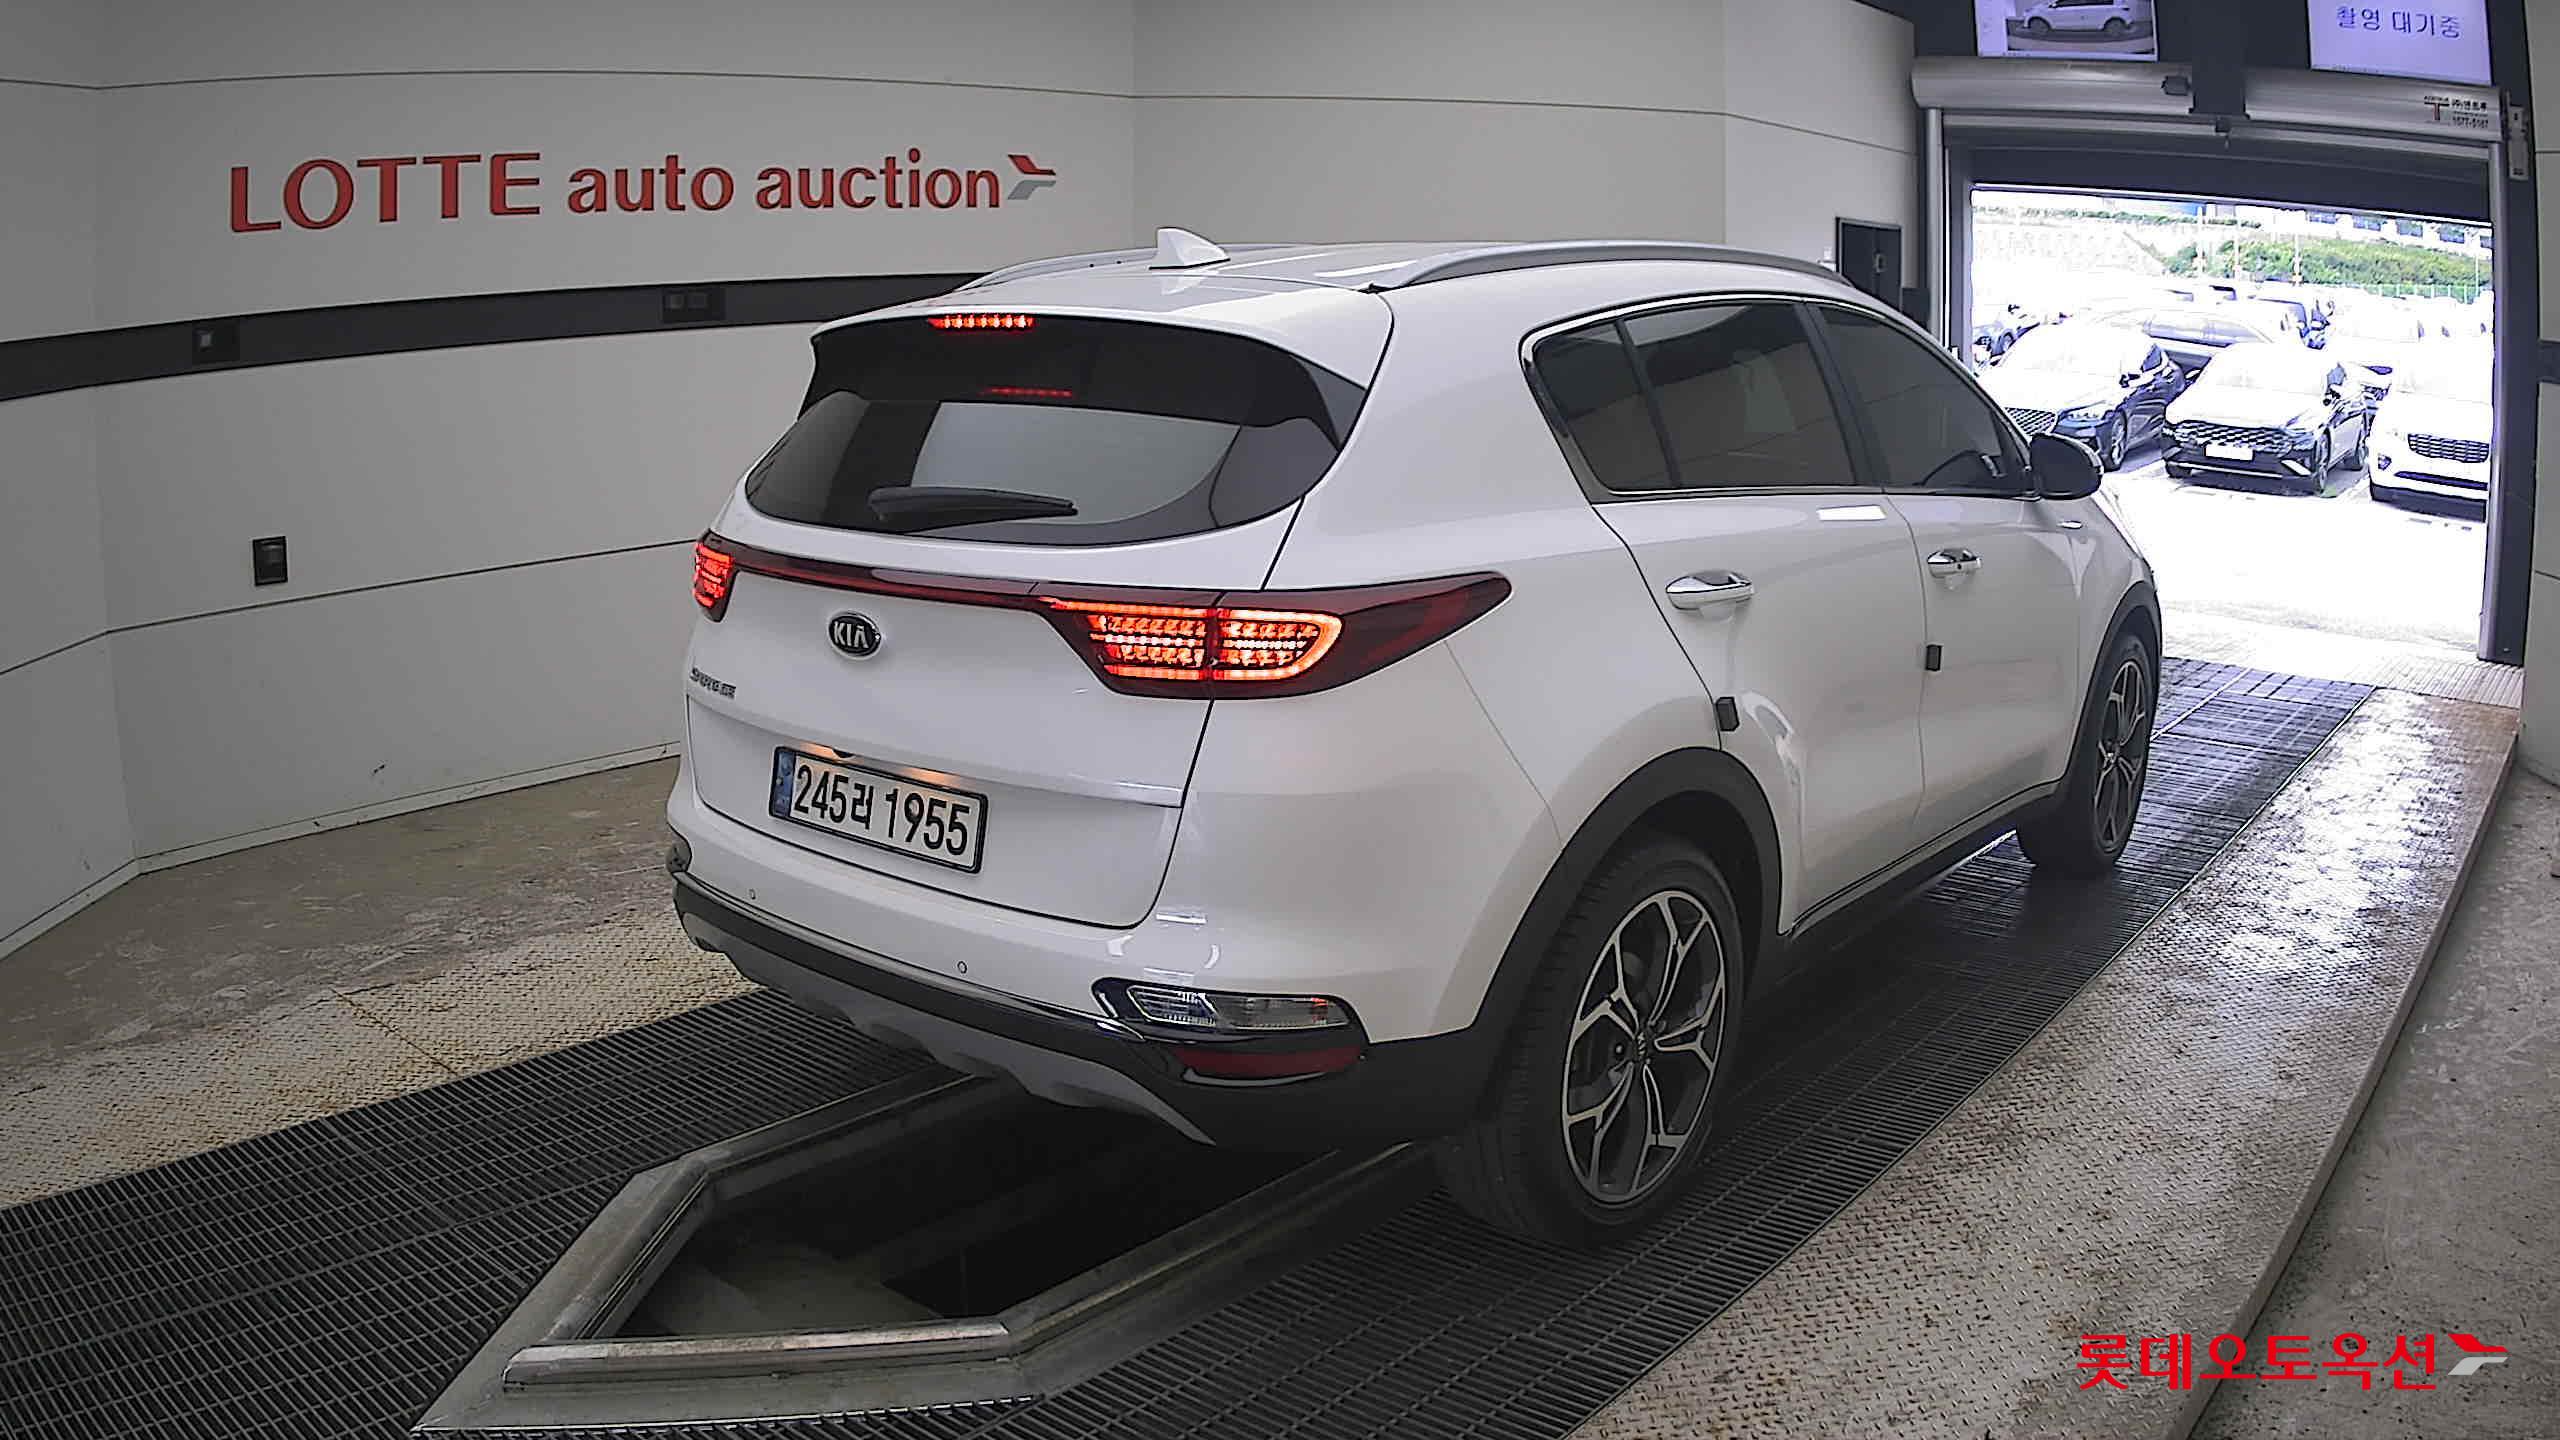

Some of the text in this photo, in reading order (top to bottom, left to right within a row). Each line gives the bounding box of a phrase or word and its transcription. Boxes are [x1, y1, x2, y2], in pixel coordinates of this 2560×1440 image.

[2336, 6, 2460, 39] 촬영 대기중
[230, 148, 1002, 233] LOTTE auto auction
[832, 621, 870, 650] KIA
[885, 787, 970, 856] 1955
